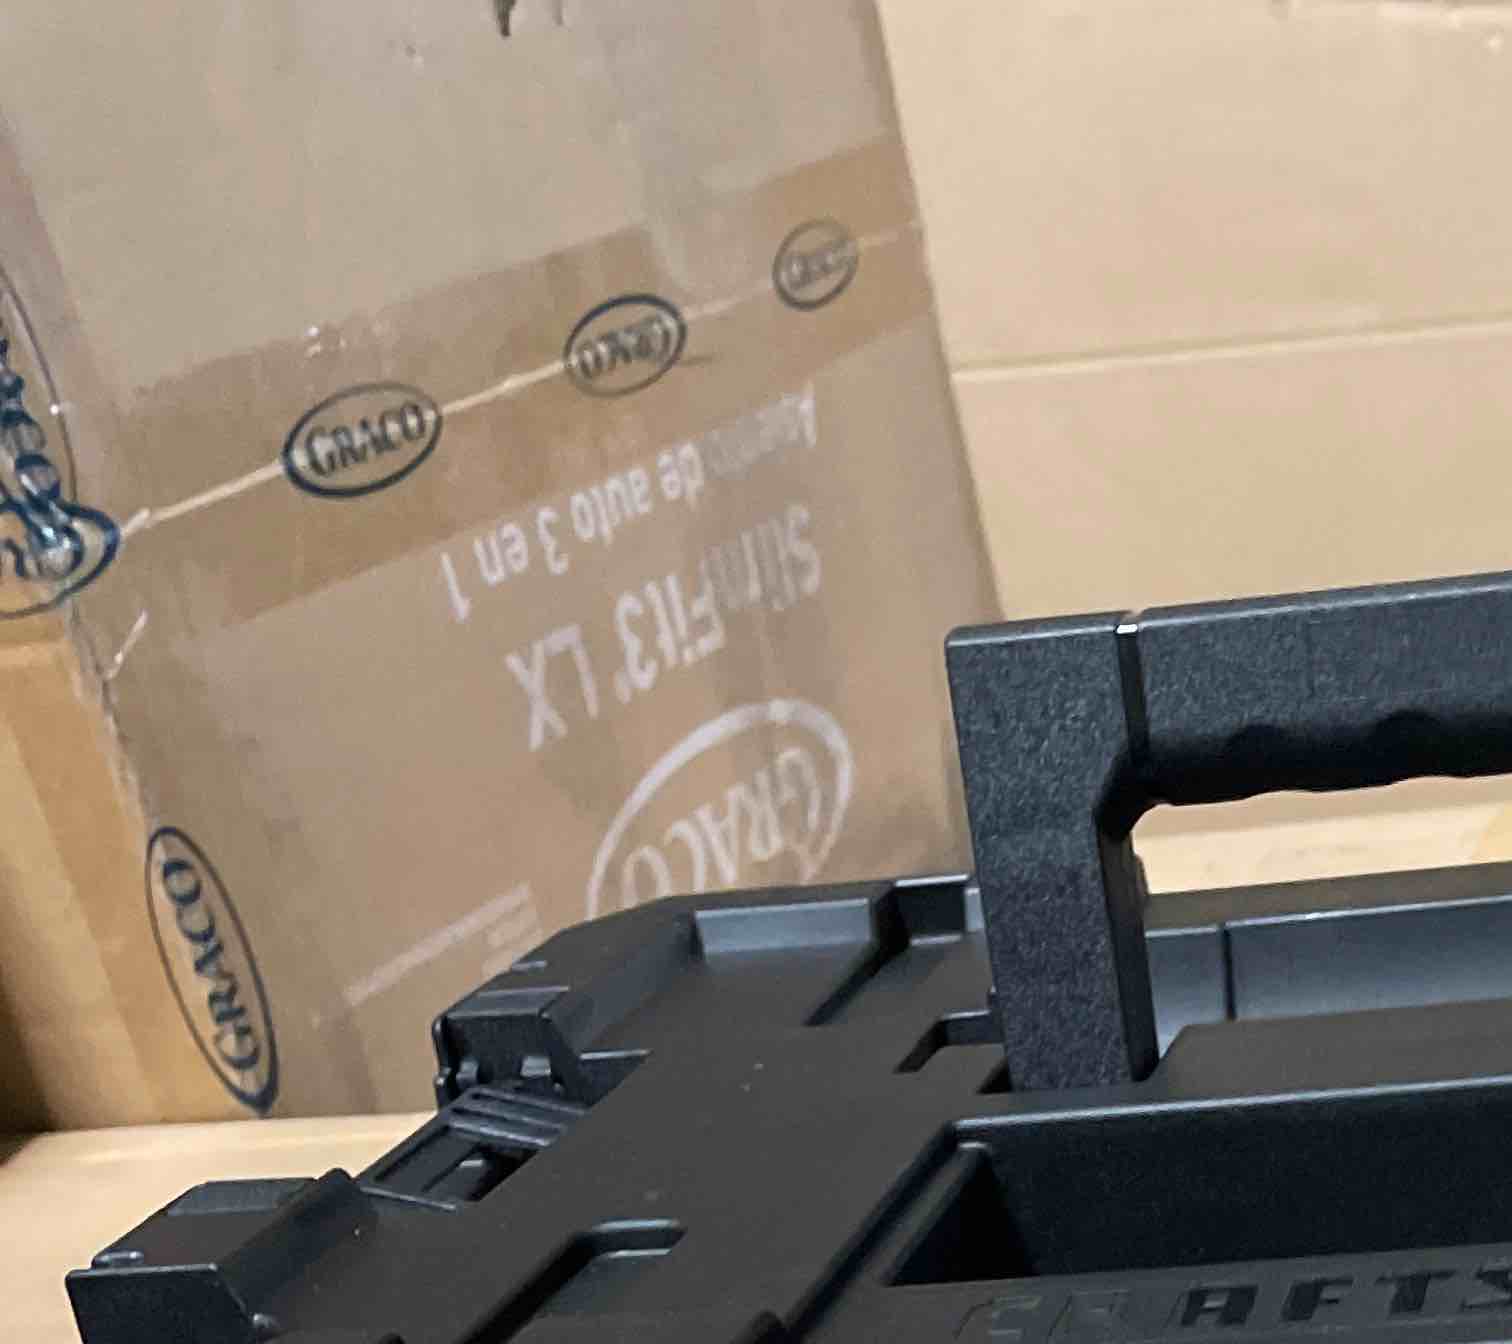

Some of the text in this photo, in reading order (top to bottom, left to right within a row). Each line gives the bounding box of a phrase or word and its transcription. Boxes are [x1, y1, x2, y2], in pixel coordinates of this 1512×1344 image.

[305, 401, 427, 478] GRACO
[440, 440, 708, 624] de auto 3 en 1
[504, 623, 599, 752] LX
[161, 856, 261, 1071] GRACO
